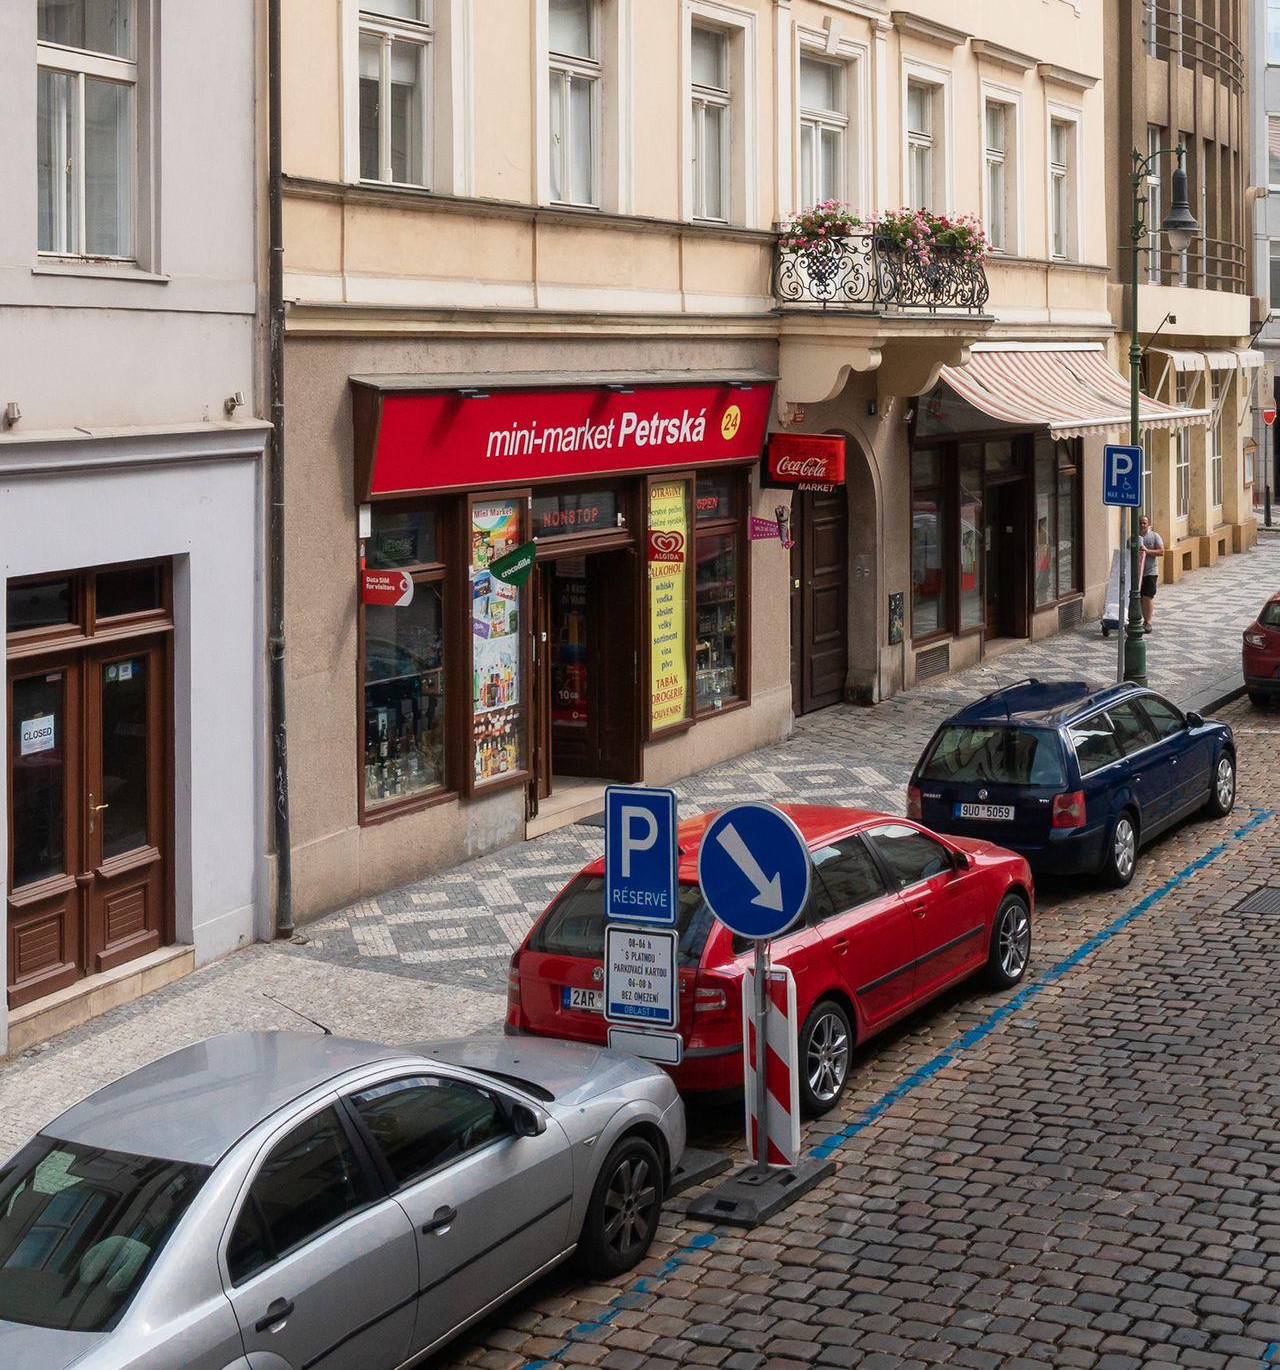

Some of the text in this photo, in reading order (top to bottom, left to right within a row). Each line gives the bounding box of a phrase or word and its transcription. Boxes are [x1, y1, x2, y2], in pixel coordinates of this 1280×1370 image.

[722, 414, 739, 433] 24
[486, 408, 707, 458] mini-market Petrská
[776, 456, 829, 477] Coca-Cola
[1112, 454, 1133, 486] P
[798, 482, 835, 493] MARKET
[696, 496, 718, 510] OPEN
[474, 507, 513, 519] Mini Market
[543, 508, 599, 528] NONSTOP
[654, 552, 679, 560] ALGIDA
[375, 583, 395, 591] visitors
[656, 581, 675, 591] whisky
[656, 594, 673, 604] vodka
[558, 690, 570, 700] 10
[651, 686, 683, 704] DROGERIE
[23, 727, 52, 741] CLOSED
[962, 805, 1010, 818] 9U0 5059
[621, 805, 659, 878] P
[613, 886, 668, 908] RÉSERVÉ
[625, 951, 656, 963] S PLATNOU
[614, 962, 667, 978] PARKOVACÍ KARTOU
[573, 990, 595, 1008] 2AR
[622, 990, 632, 1000] BEZ
[624, 1005, 651, 1017] OBLAST
